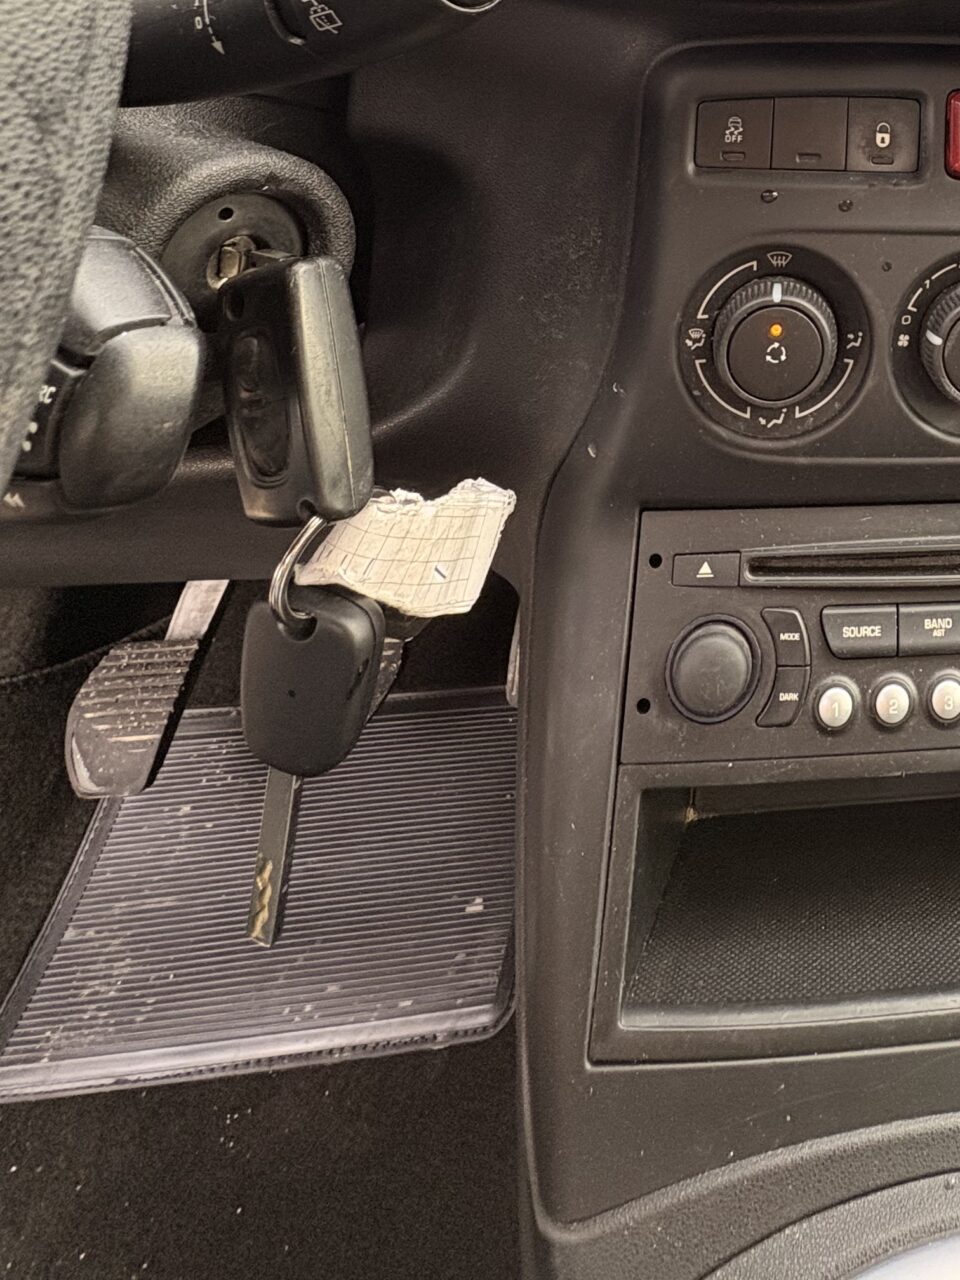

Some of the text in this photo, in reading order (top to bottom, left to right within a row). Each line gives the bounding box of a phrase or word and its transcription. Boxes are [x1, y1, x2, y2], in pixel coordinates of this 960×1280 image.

[724, 134, 743, 143] OFF
[924, 279, 931, 289] 1
[901, 315, 911, 325] 0
[924, 617, 953, 630] BAND
[780, 632, 801, 641] MODE
[842, 626, 882, 638] SOURCE
[932, 629, 946, 637] AST
[779, 692, 799, 701] DARK
[889, 699, 898, 714] 2
[943, 694, 953, 710] 3
[831, 702, 839, 717] 1
